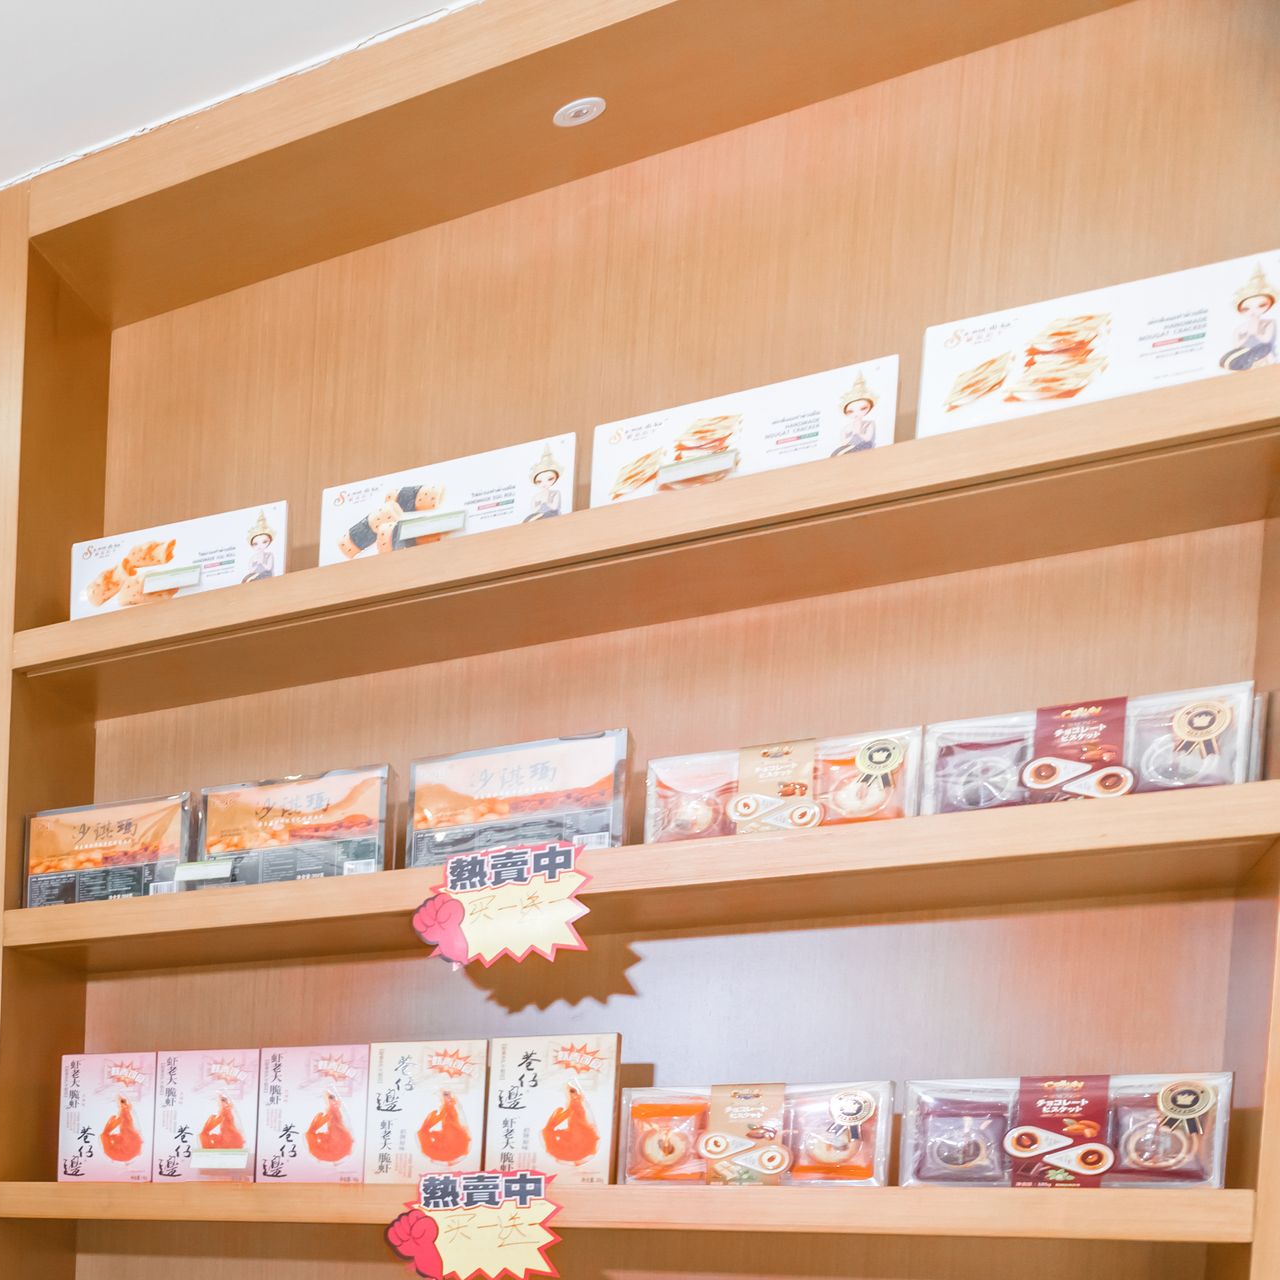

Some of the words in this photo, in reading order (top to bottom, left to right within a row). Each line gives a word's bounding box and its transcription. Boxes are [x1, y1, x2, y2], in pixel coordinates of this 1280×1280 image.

[1053, 722, 1107, 739] チョコレート
[1060, 732, 1101, 744] ビスケット
[447, 845, 576, 888] 熱賣中
[1037, 1098, 1088, 1107] チョコレート
[420, 1174, 545, 1209] 熱賣中
